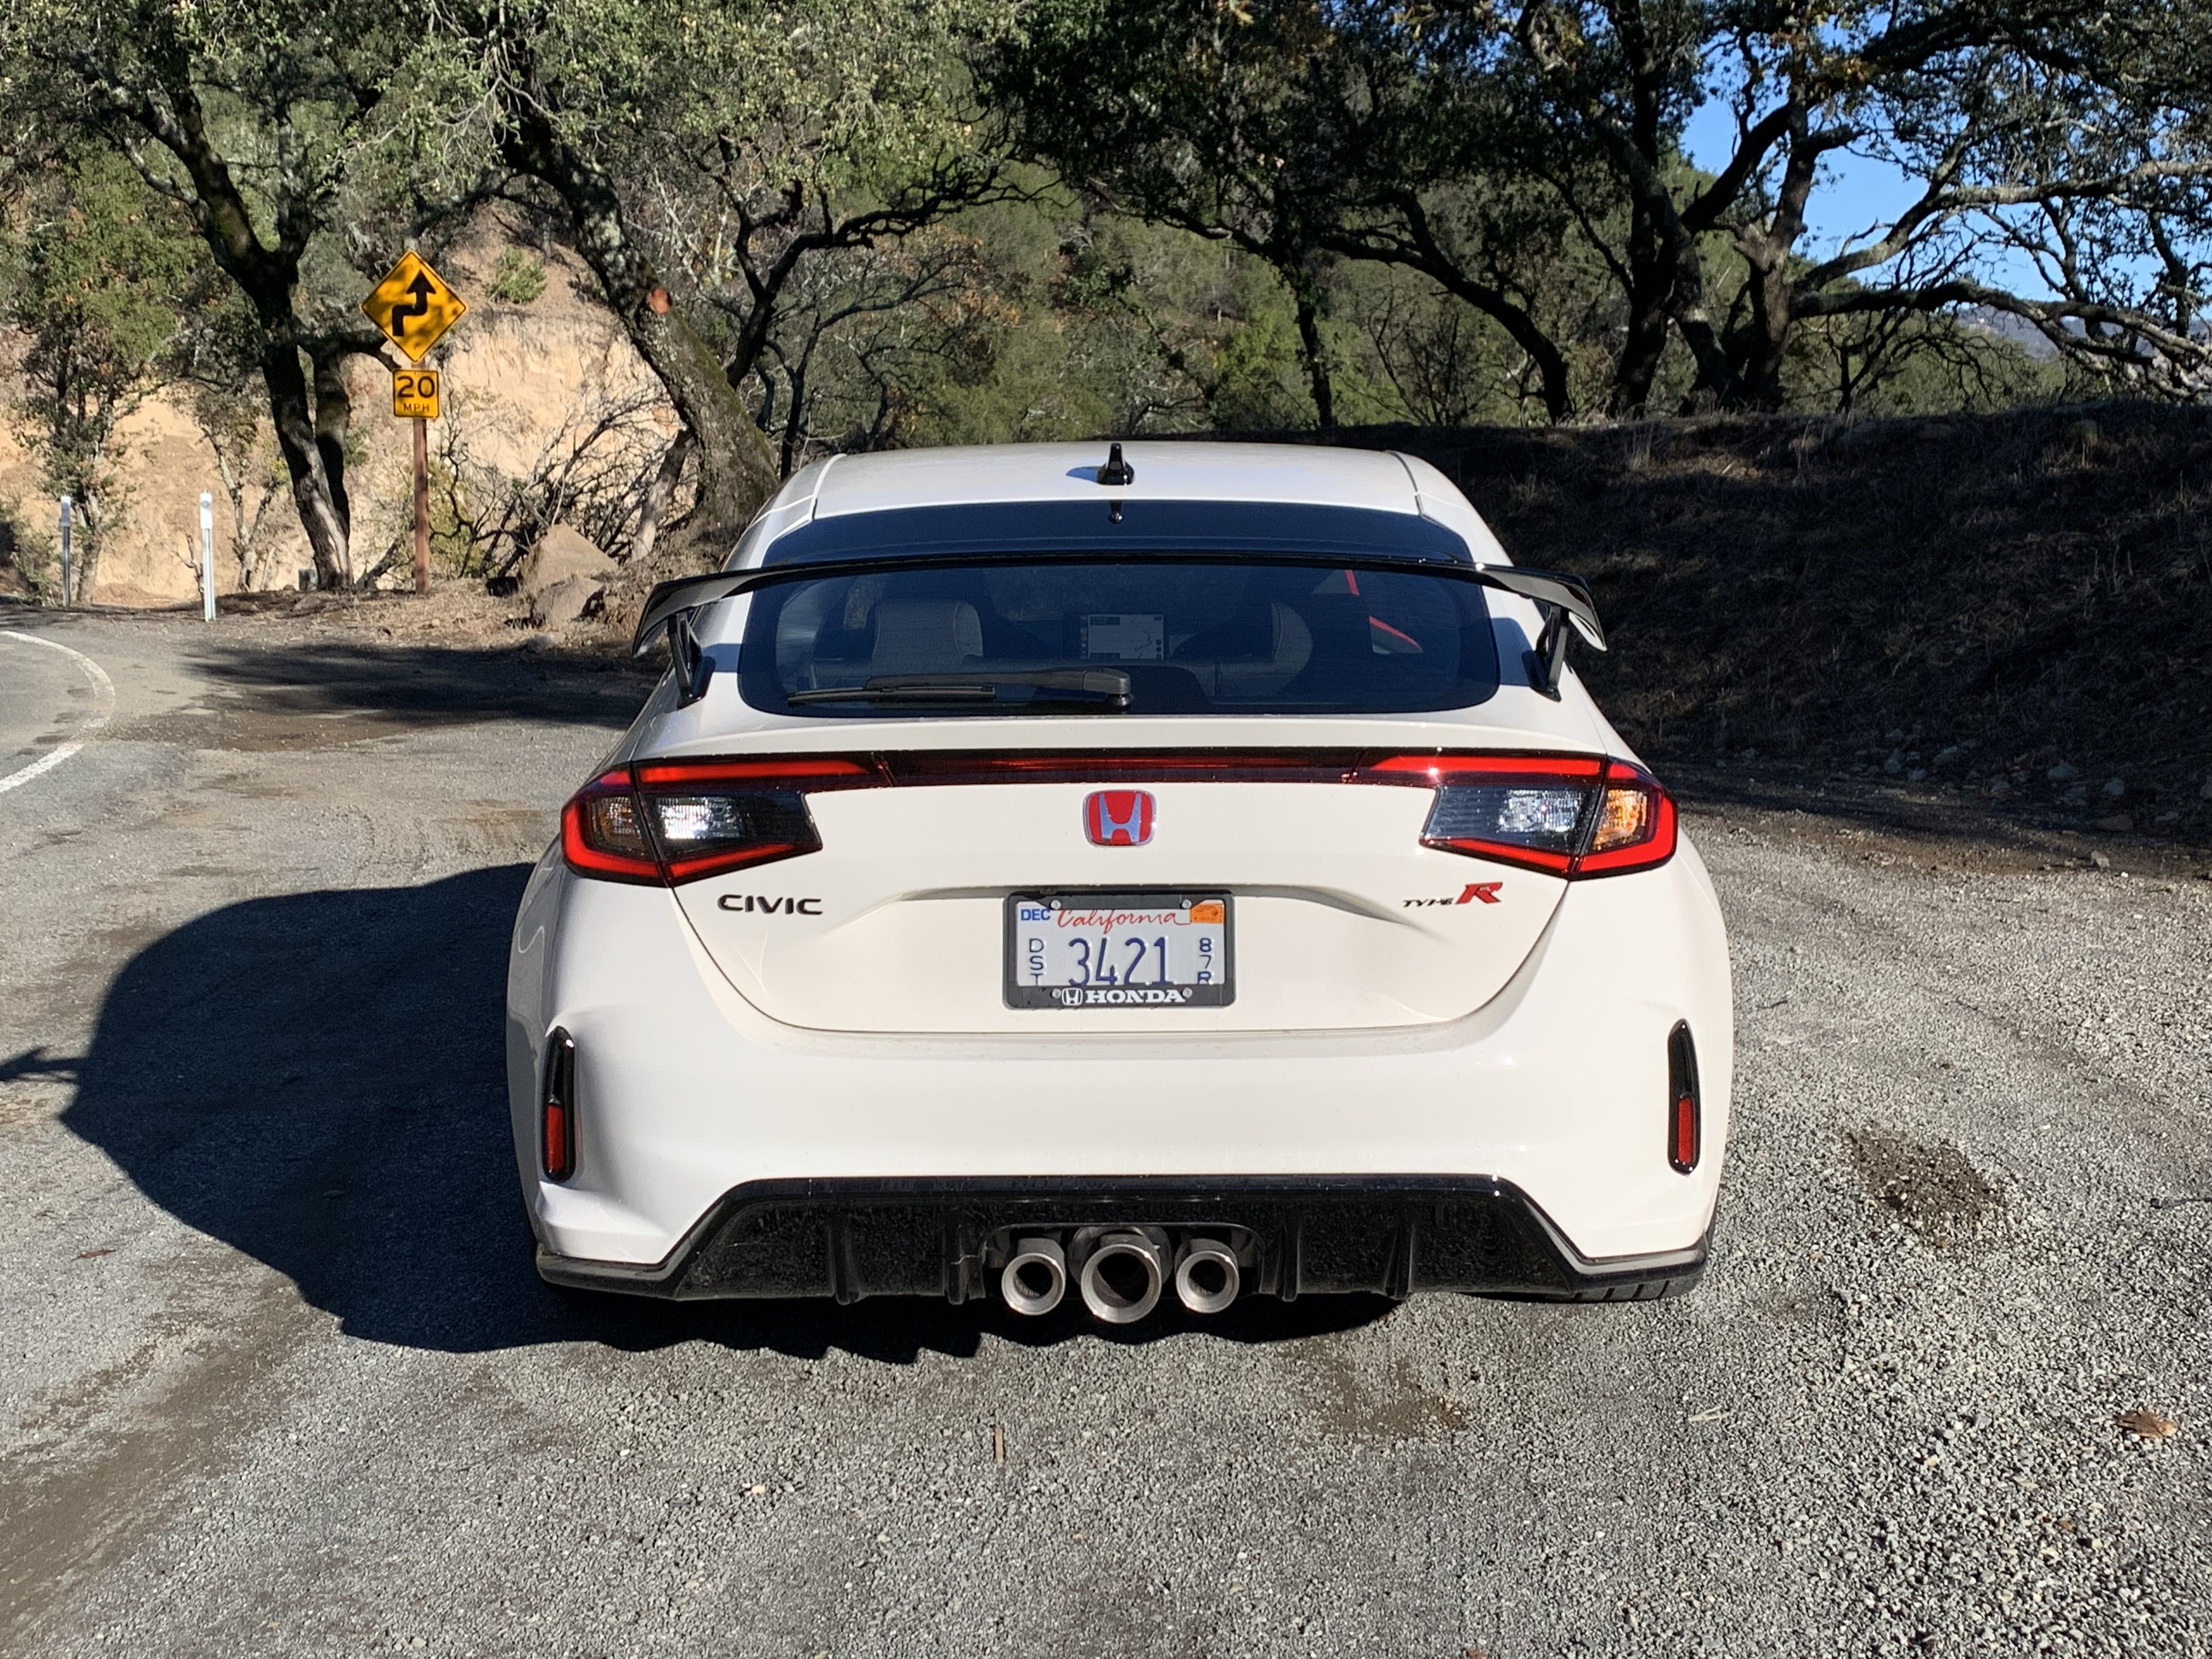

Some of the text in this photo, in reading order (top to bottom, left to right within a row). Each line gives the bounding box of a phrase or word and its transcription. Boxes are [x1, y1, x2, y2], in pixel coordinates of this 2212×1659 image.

[397, 375, 435, 399] 20
[403, 403, 429, 411] MPH
[717, 894, 823, 916] CIVIC
[1454, 882, 1503, 905] R
[1021, 909, 1051, 921] DEC
[1057, 909, 1191, 934] California
[1029, 938, 1044, 986] DST
[1069, 936, 1174, 986] 3421
[1085, 990, 1186, 1003] HONDA
